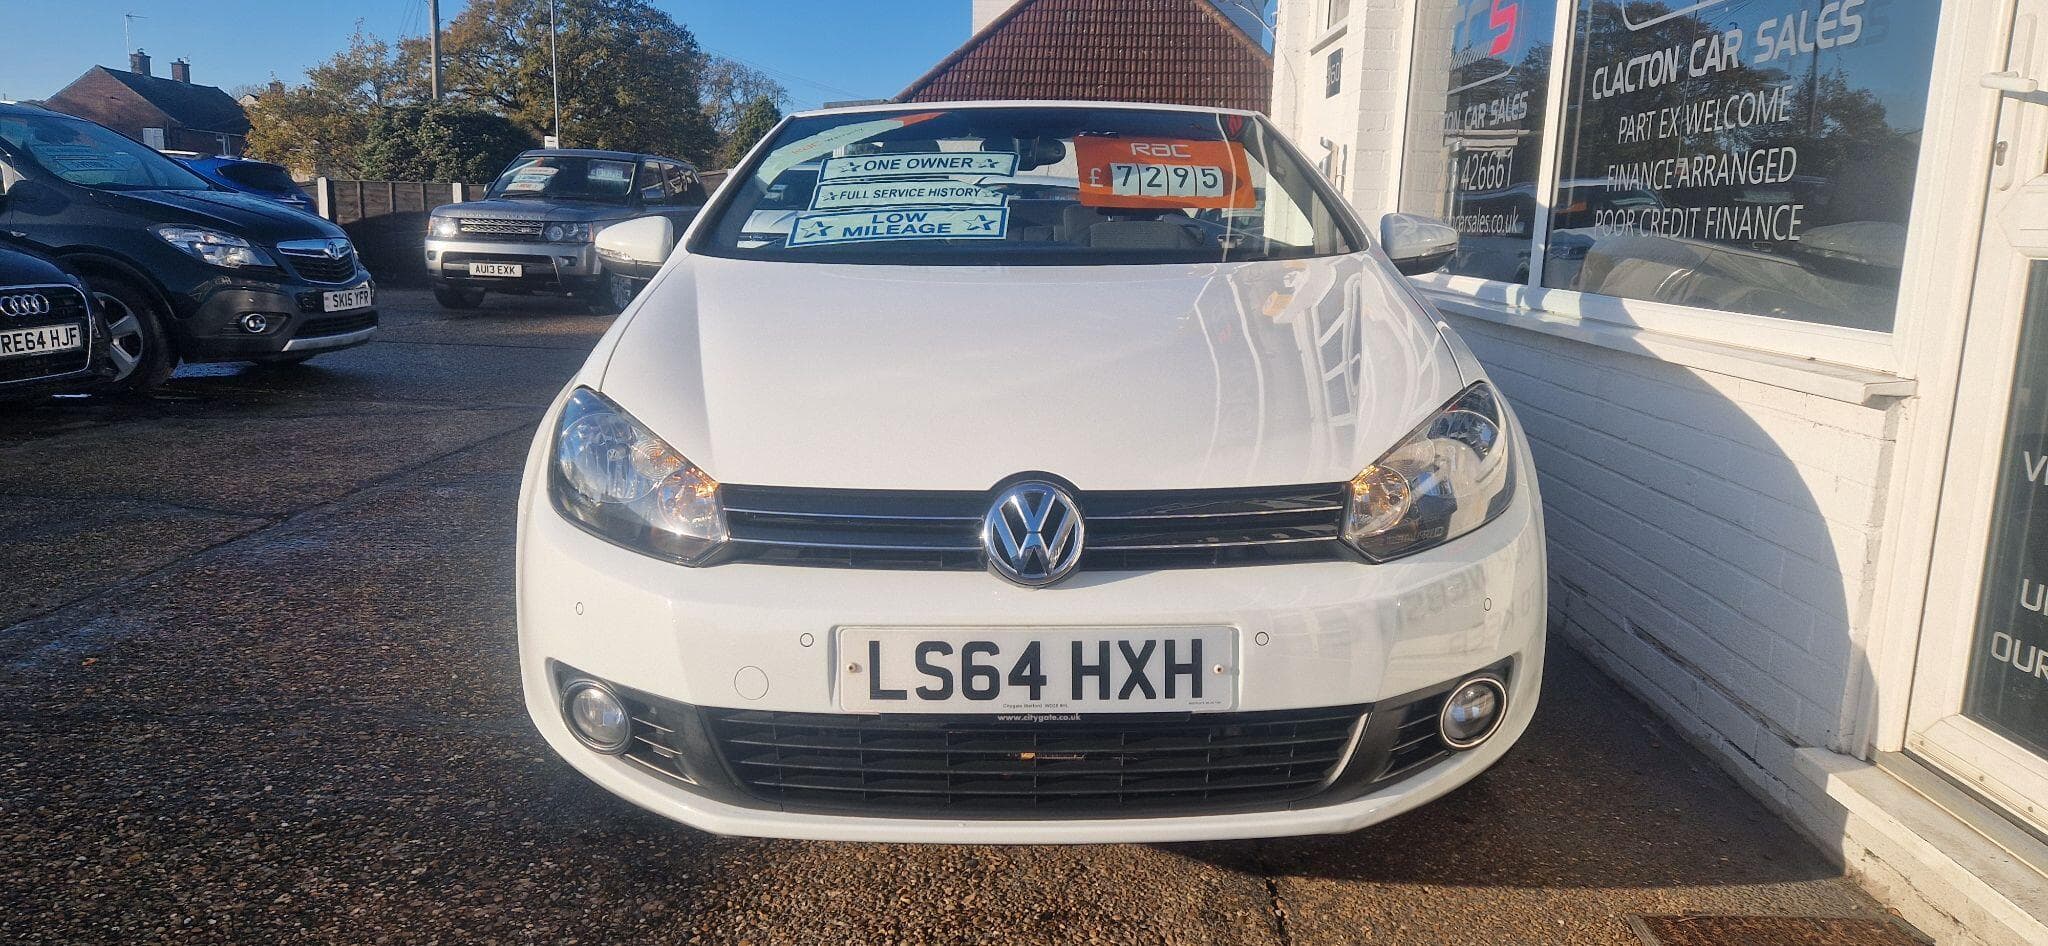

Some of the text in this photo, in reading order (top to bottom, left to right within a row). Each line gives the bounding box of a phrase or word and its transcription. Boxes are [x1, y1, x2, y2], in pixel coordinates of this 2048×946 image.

[1592, 0, 1866, 100] CLACTON CAR SALES
[1464, 102, 1487, 131] CAR
[1490, 90, 1529, 126] SALES
[1618, 85, 1794, 144] PART EX WELCOME
[863, 157, 974, 171] ONE OWNER
[1606, 146, 1798, 192] FINANCE ARRANGED
[839, 187, 982, 200] FULL SERVICE HISTORY
[871, 212, 928, 224] LOW
[1594, 204, 1805, 241] POOR CREDIT FINANCE
[842, 223, 952, 238] MILEAGE
[475, 264, 515, 275] AU13 EXK
[332, 290, 369, 308] SK15 YFR
[0, 327, 77, 353] RE64 HJF
[868, 639, 1203, 701] LS64 HXH
[997, 713, 1081, 723] www.citygate.co.uk
